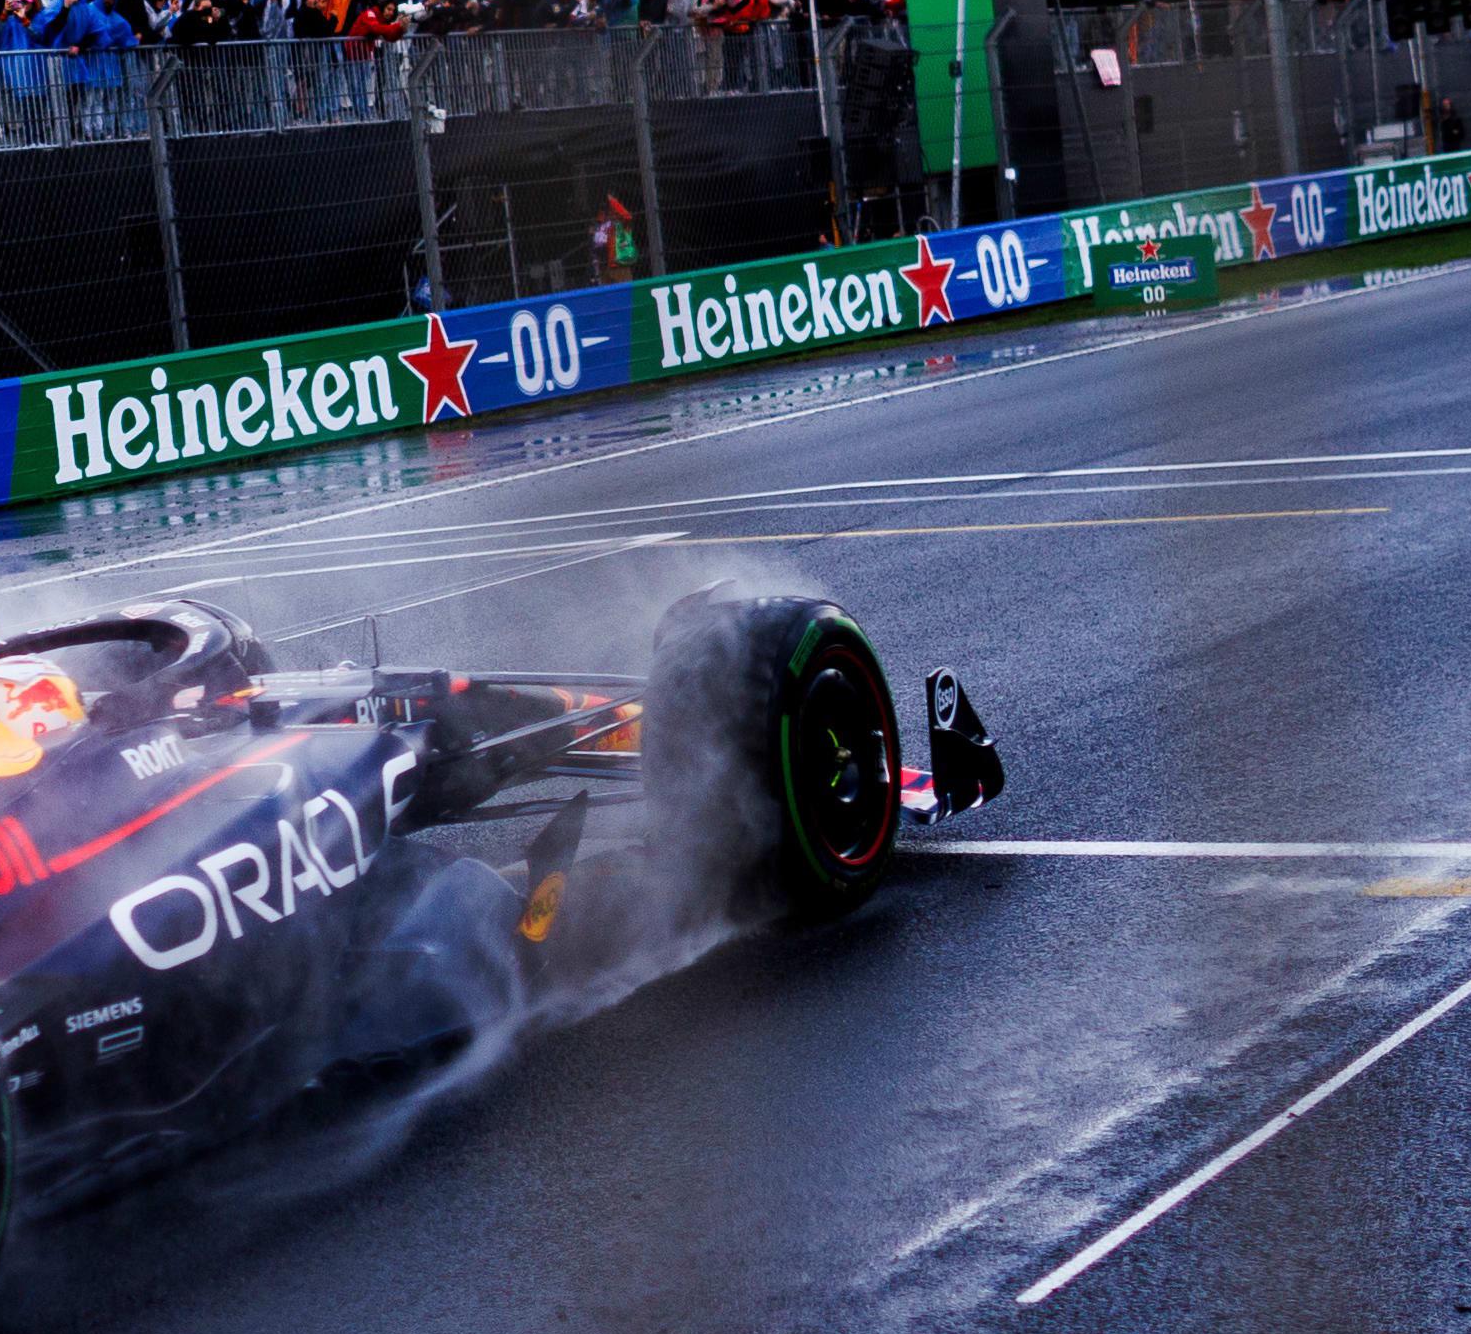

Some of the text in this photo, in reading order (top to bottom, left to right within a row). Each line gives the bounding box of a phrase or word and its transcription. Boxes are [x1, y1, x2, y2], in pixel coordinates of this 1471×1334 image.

[1291, 181, 1325, 247] 0.0
[1355, 165, 1468, 235] Heineken
[650, 229, 1031, 369] Heineken 0.0
[1113, 263, 1191, 284] Heineken
[45, 304, 582, 485] Heineken 0.0
[938, 686, 954, 713] Esso
[120, 734, 185, 780] ROKT
[109, 750, 417, 970] ORACLE
[65, 996, 145, 1034] SIEMENS
